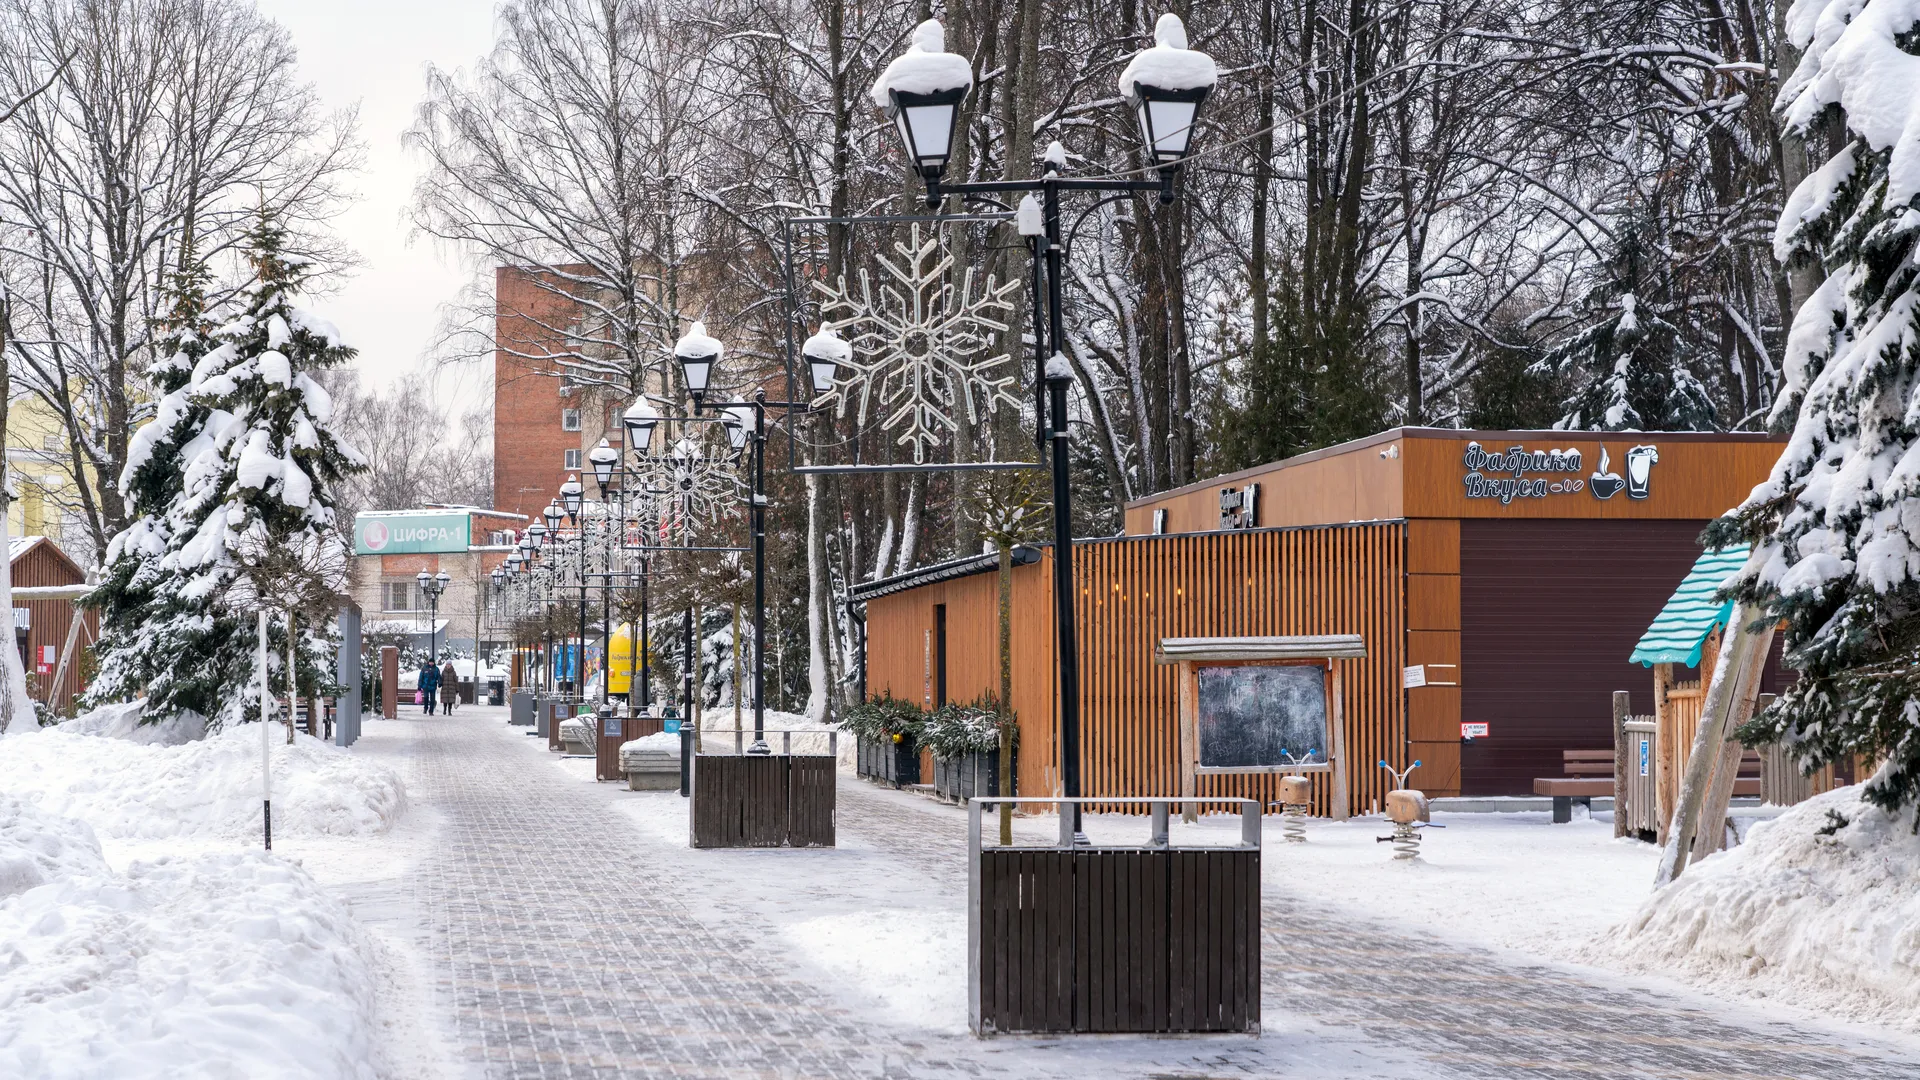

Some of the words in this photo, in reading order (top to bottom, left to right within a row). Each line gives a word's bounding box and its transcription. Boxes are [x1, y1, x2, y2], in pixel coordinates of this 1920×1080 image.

[1464, 443, 1582, 478] Фабрика
[1464, 472, 1548, 505] Вкуса
[12, 608, 30, 630] ХОД
